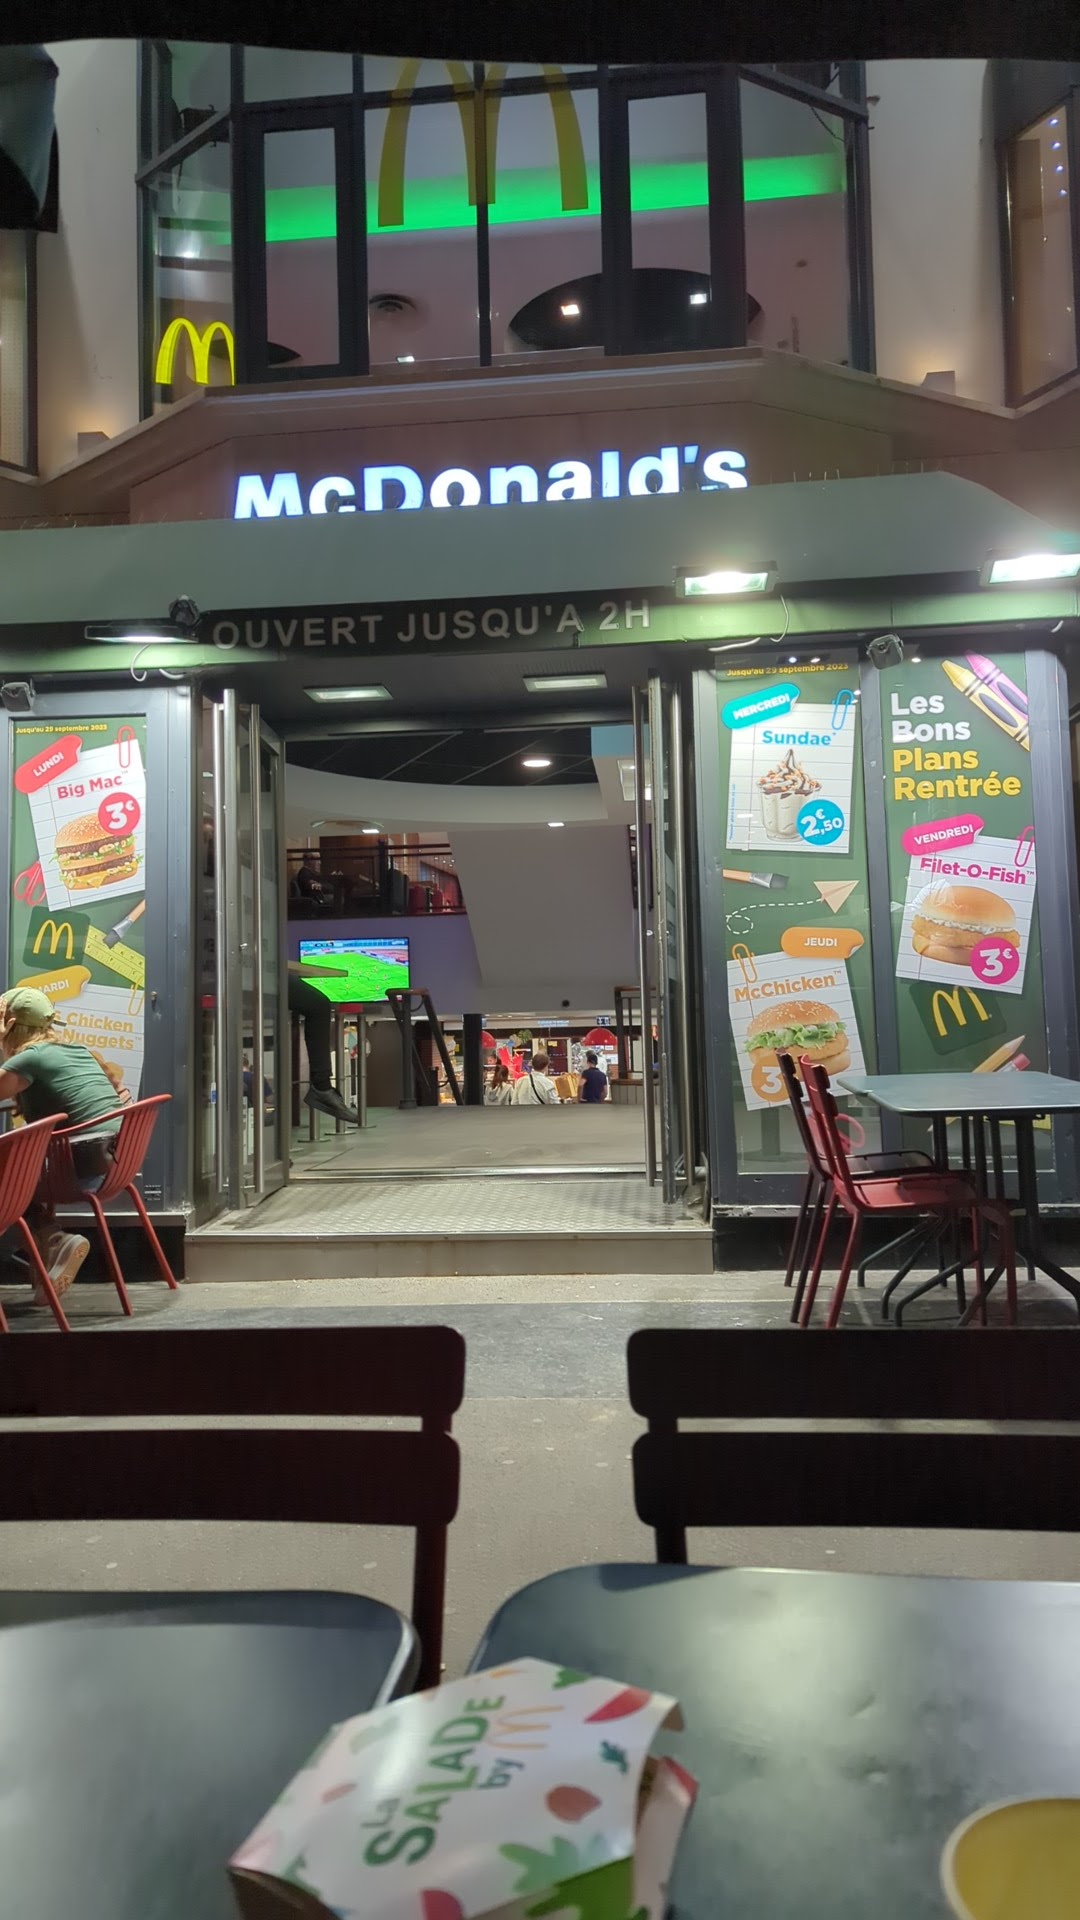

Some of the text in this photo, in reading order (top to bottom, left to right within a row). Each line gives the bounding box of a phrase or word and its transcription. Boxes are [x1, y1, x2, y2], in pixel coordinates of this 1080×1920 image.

[233, 445, 750, 519] McDonald's
[212, 599, 652, 650] OUVERT JUSQU'A 2H
[726, 663, 849, 677] Jusqu'au 29 septembre 2023
[732, 693, 791, 720] MERCREDI
[890, 692, 945, 716] Les
[16, 726, 44, 735] Jusqu'au
[55, 724, 90, 734] septembre
[891, 720, 972, 744] Bons
[33, 752, 64, 777] LUNDI
[893, 748, 979, 773] Plans
[57, 784, 85, 800] Big
[893, 771, 1022, 801] Rentrée
[914, 824, 974, 845] VENDREDI
[804, 937, 838, 947] JEUDI
[38, 979, 69, 994] ARDI
[66, 1012, 133, 1033] Chicken
[363, 1694, 506, 1867] SALADE
[476, 1758, 525, 1790] by
